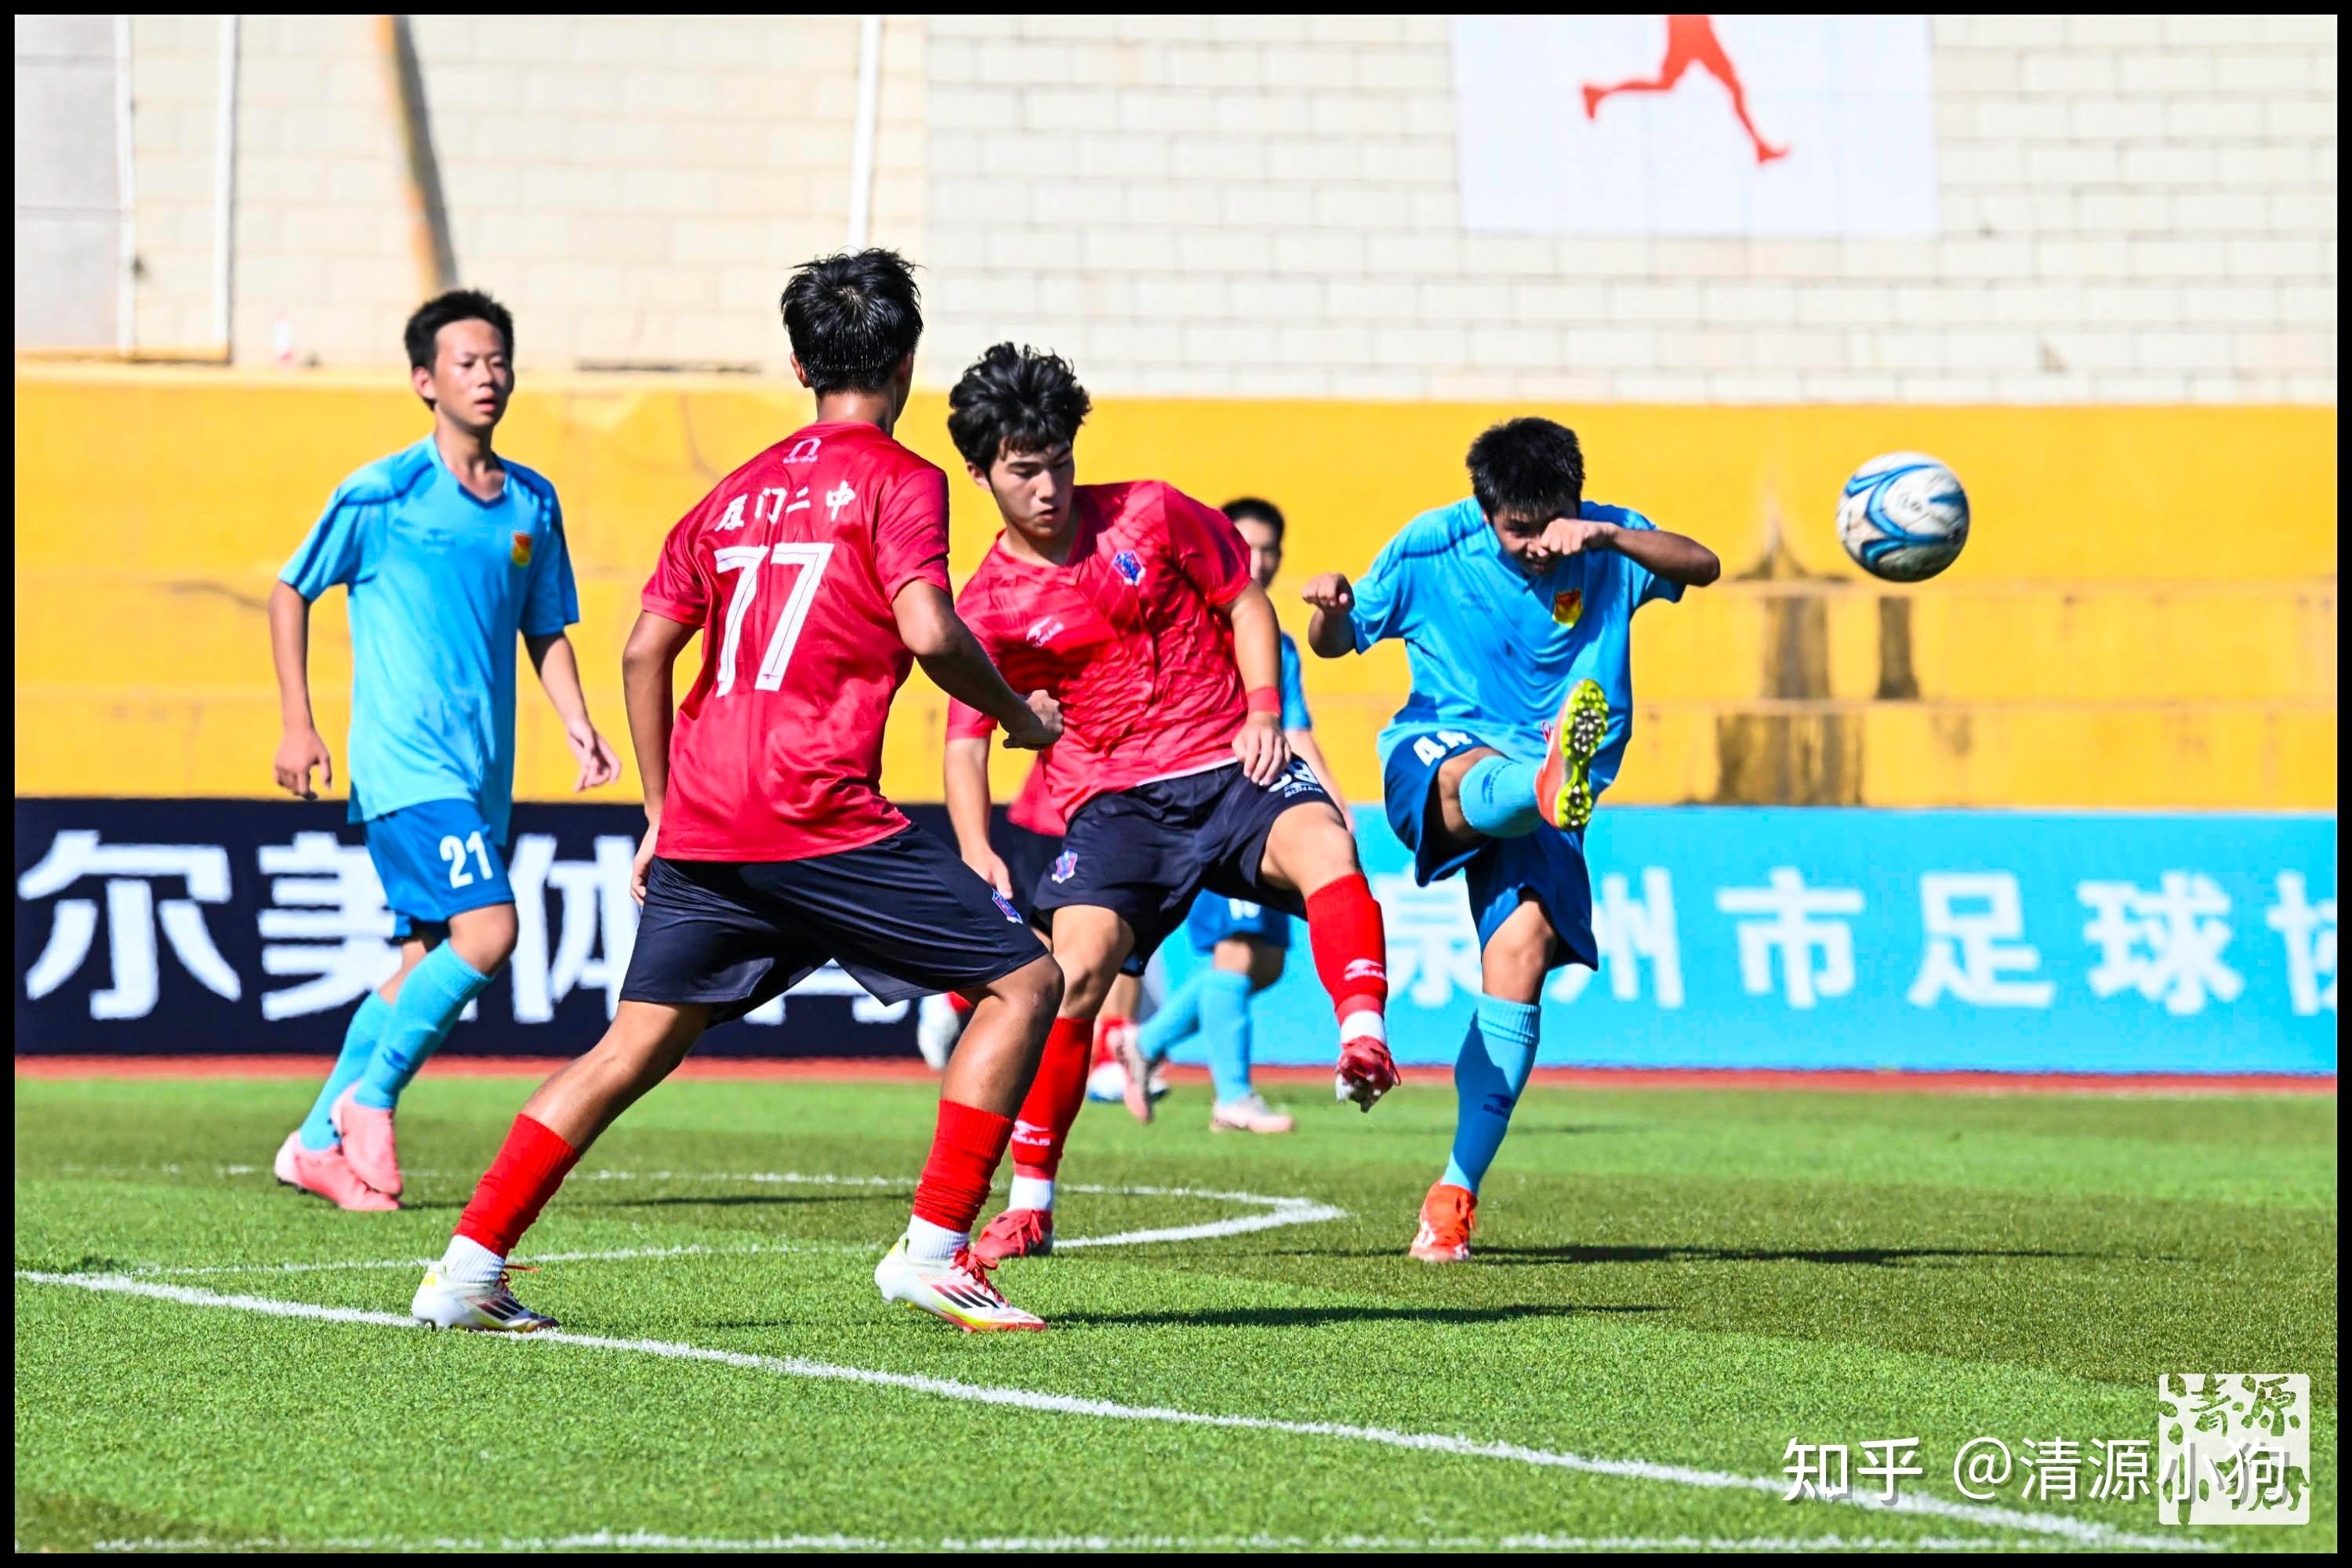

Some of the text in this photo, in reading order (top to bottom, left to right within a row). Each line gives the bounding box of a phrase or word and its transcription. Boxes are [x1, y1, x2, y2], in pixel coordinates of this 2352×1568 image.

[714, 542, 834, 697] 77
[17, 830, 911, 1025] 尔美体
[440, 830, 494, 889] 21
